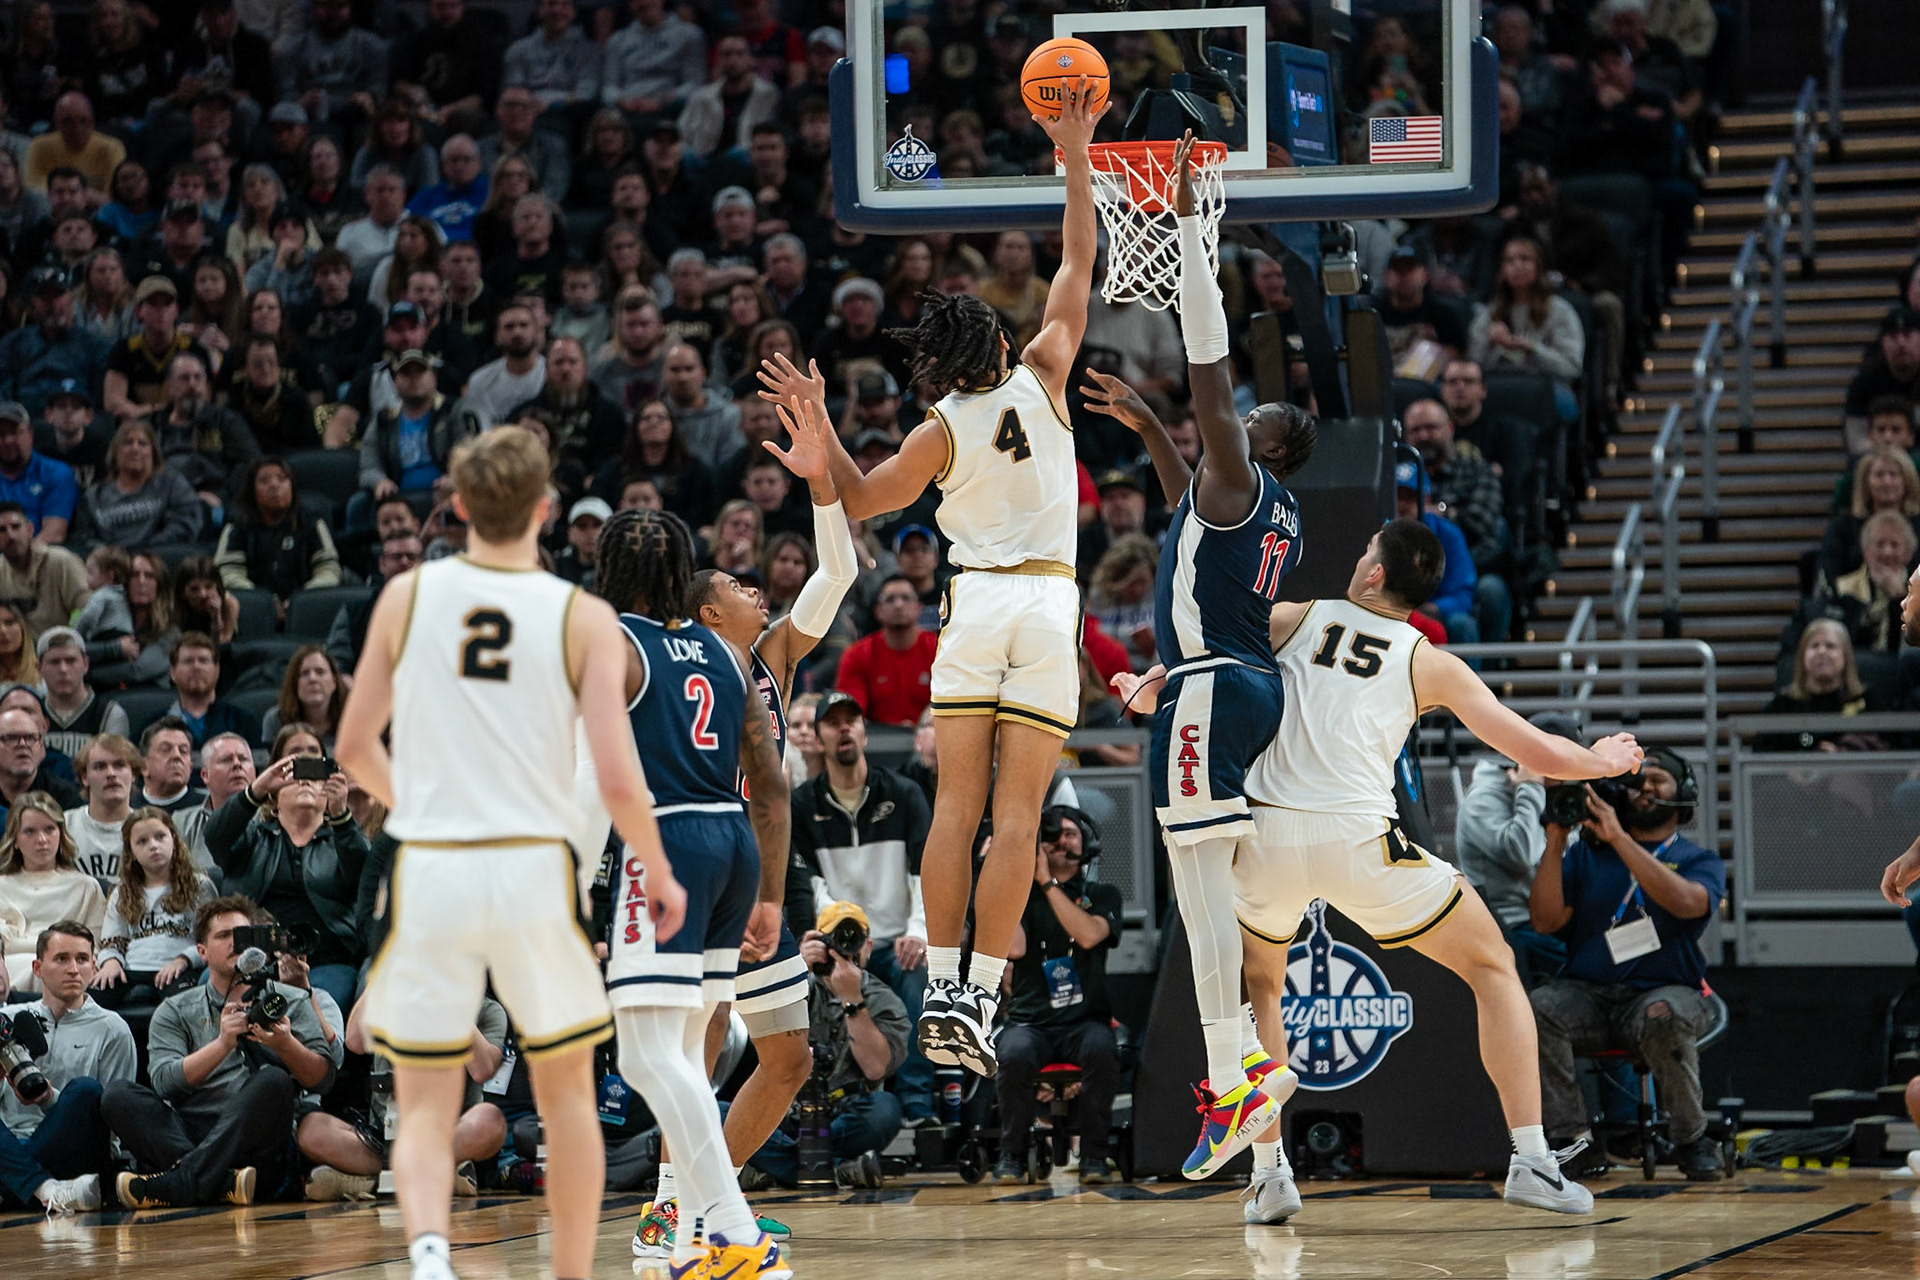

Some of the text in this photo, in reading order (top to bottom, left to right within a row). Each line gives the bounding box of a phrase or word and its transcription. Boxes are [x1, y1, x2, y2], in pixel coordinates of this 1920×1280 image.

[991, 406, 1033, 464] 4
[1253, 531, 1290, 600] 11
[459, 606, 512, 682] 2
[662, 637, 708, 664] LOVE
[1310, 621, 1392, 679] 15
[684, 674, 719, 750] 2
[1177, 725, 1200, 797] CATS
[624, 856, 647, 944] CATS
[1282, 997, 1408, 1038] dy CLASSIC
[1314, 1060, 1330, 1074] 23
[1234, 1115, 1260, 1140] FAITH
